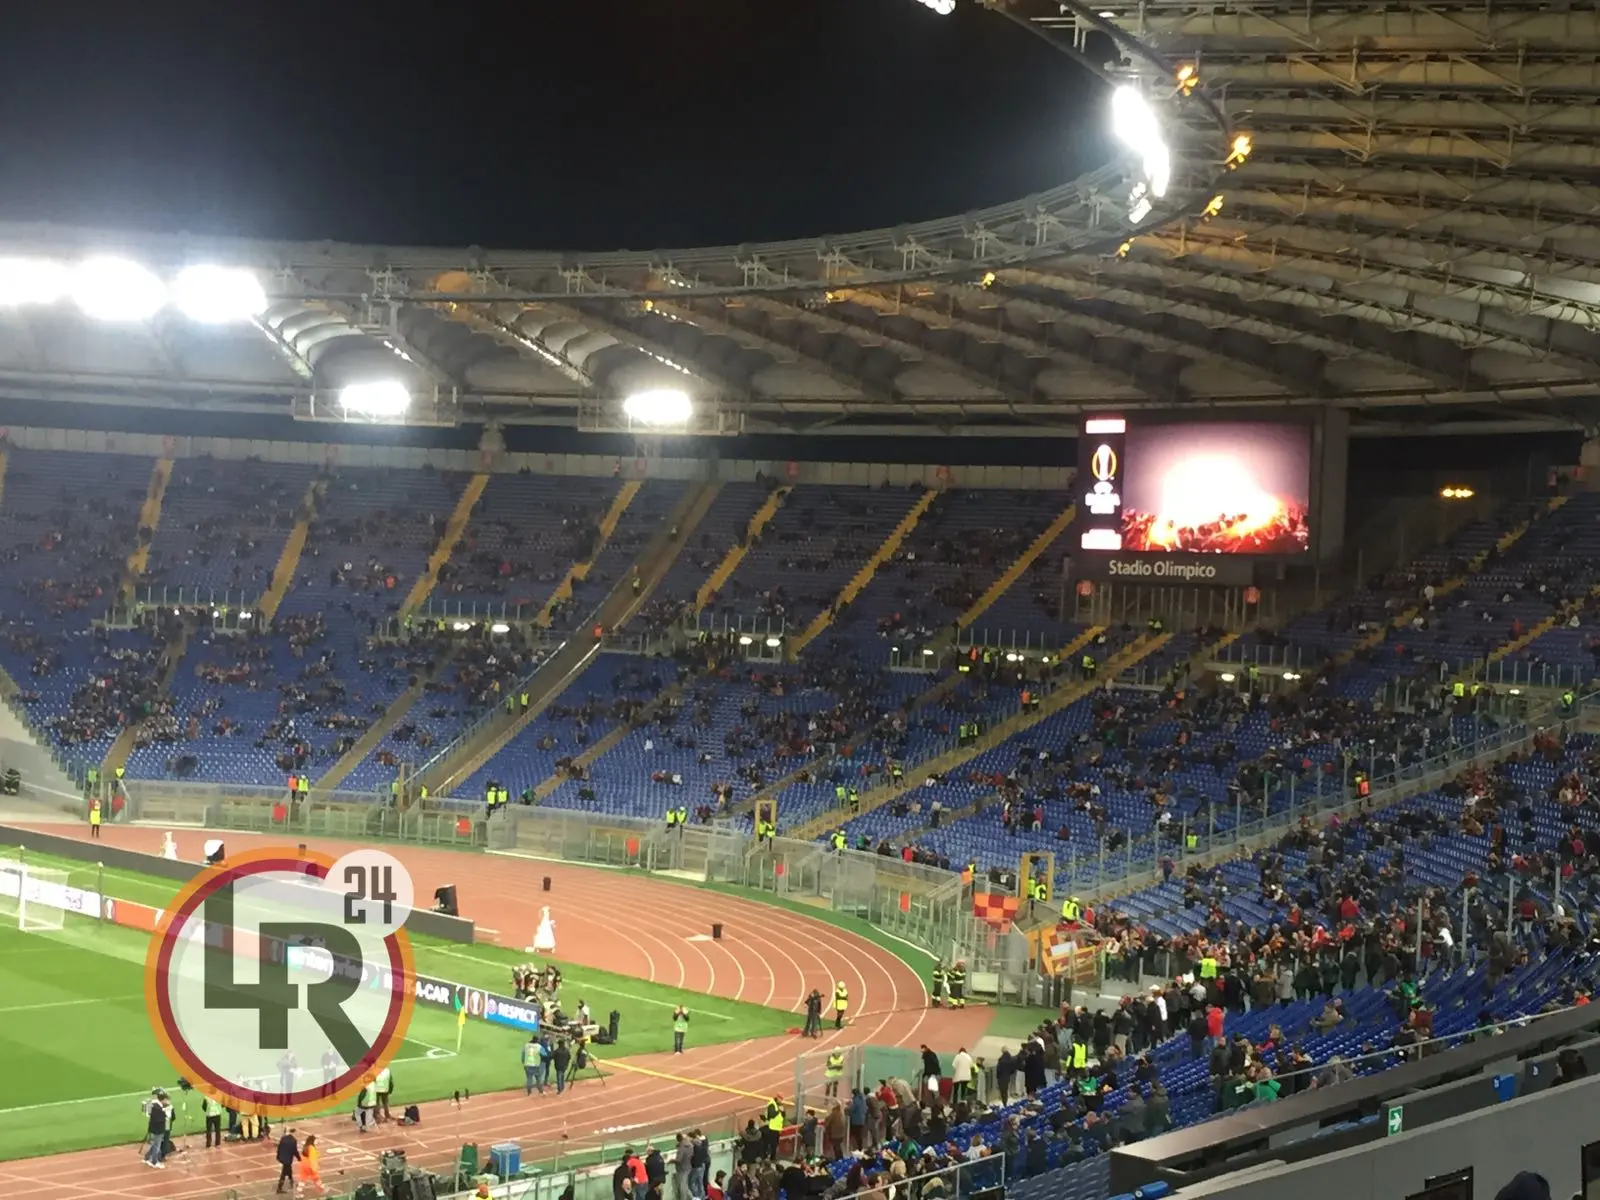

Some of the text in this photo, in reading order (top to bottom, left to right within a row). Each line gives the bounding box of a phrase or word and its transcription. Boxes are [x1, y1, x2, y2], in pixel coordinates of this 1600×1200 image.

[1109, 559, 1216, 580] Stadio Olimpico
[498, 1001, 538, 1025] RESPECT
